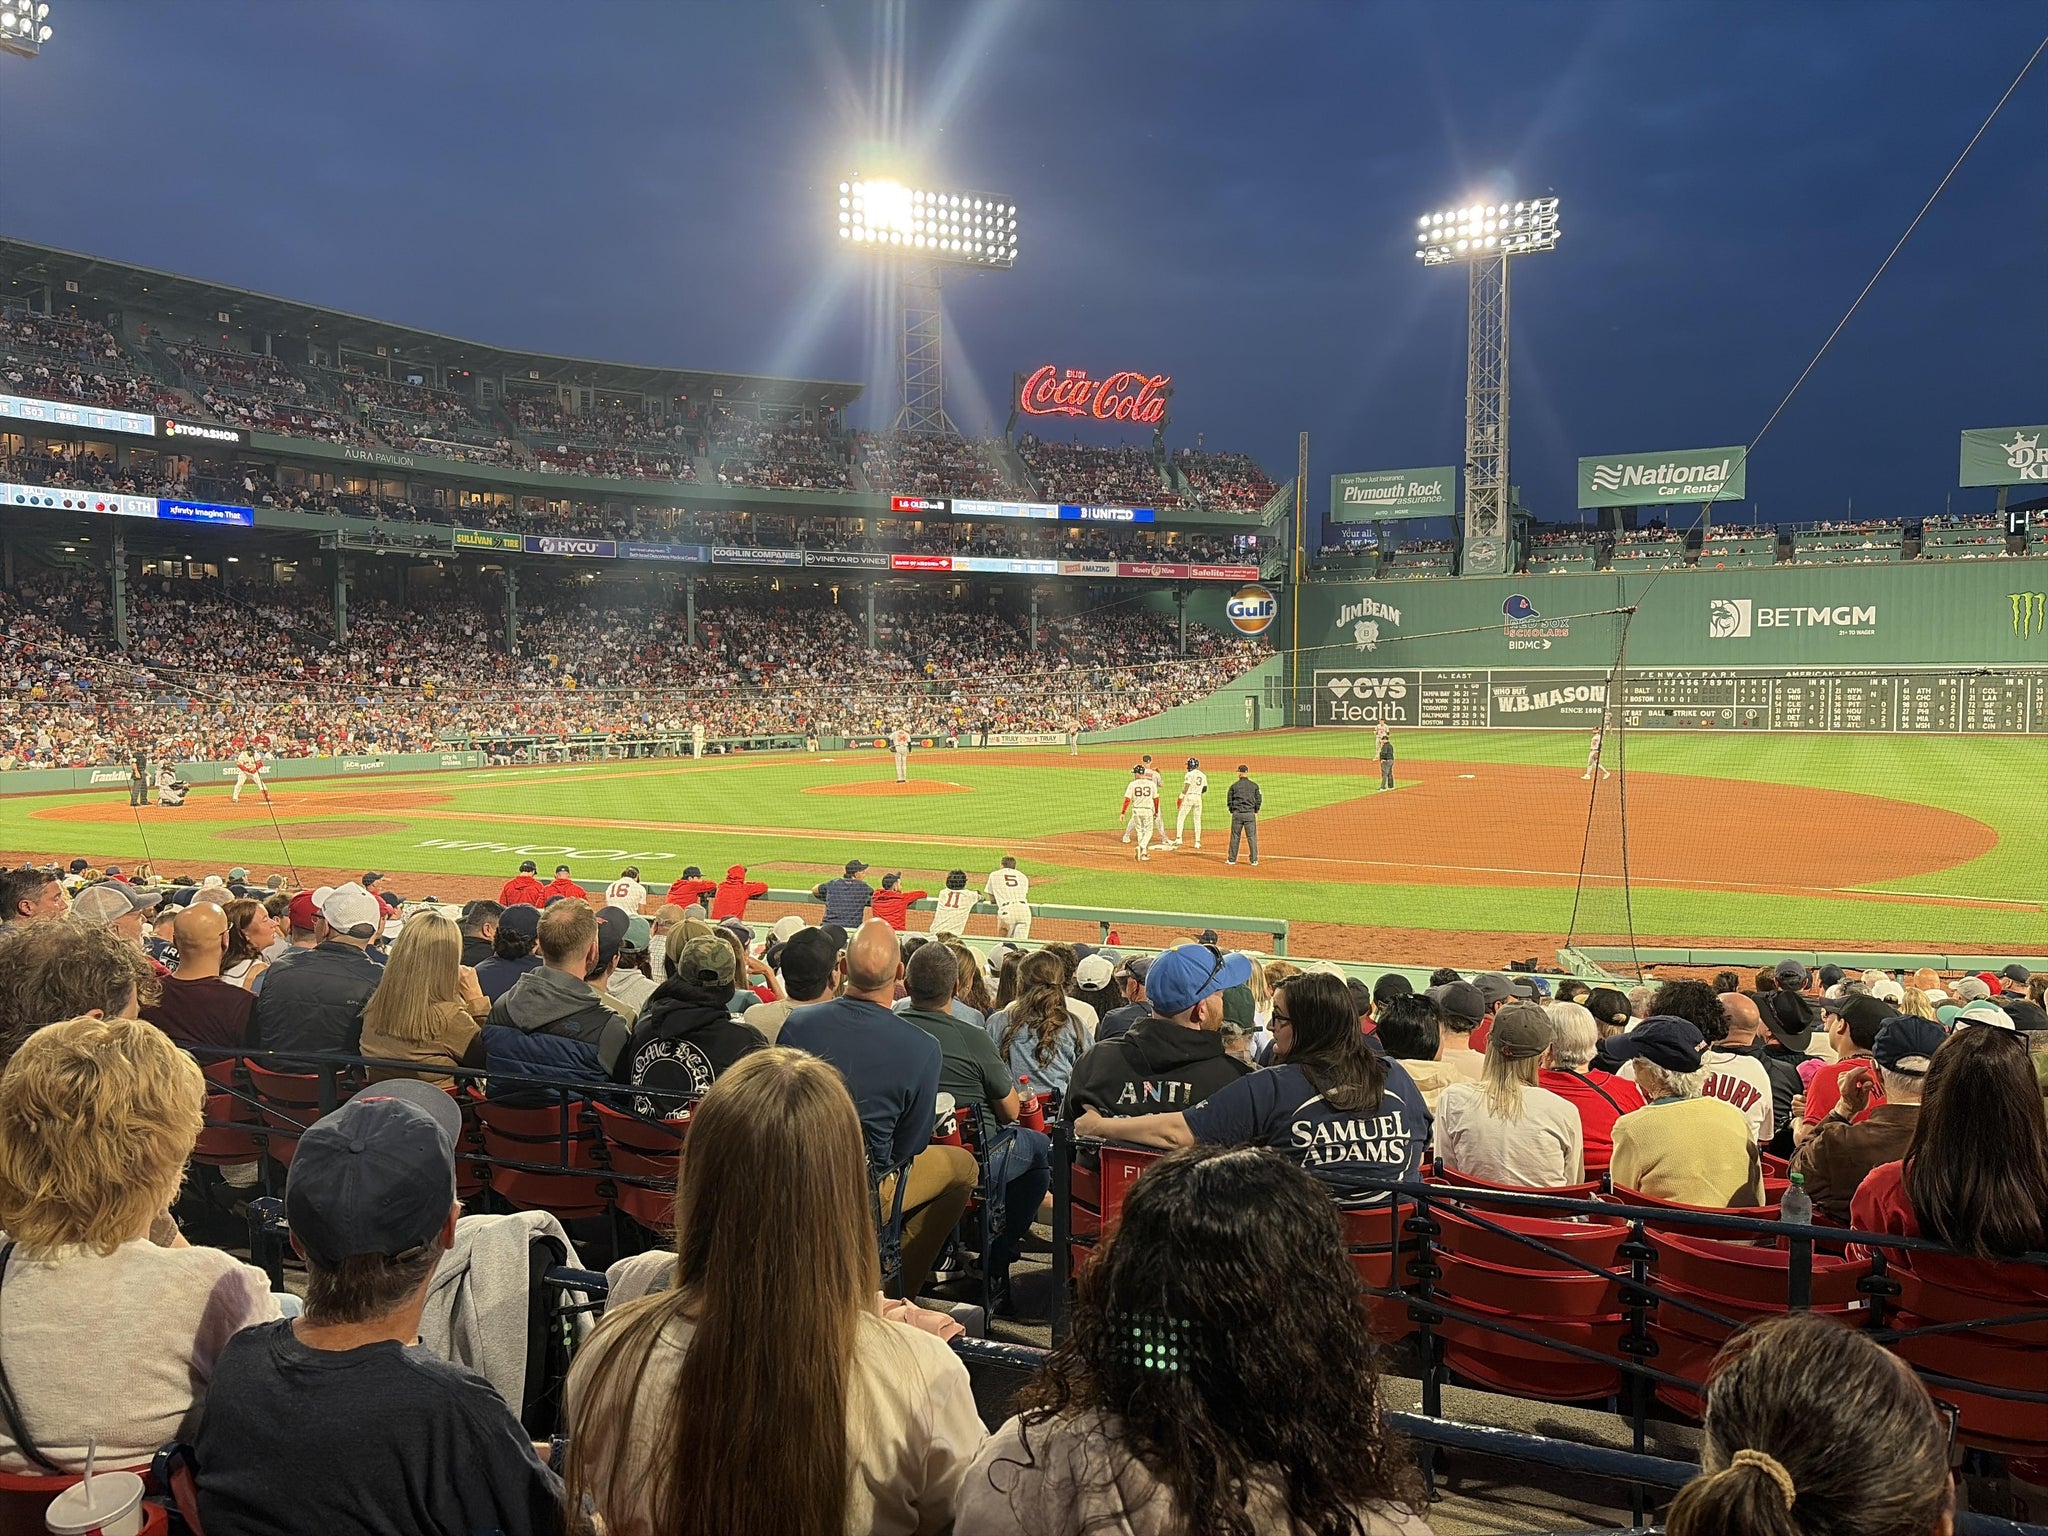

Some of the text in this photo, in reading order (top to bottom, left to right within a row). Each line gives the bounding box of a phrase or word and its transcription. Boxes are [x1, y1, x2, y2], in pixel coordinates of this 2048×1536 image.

[1067, 370, 1087, 379] ENJOY
[1022, 365, 1171, 422] Coca-Cola
[376, 453, 414, 467] PAVILION
[1622, 459, 1730, 486] National
[1344, 480, 1442, 504] Plymouth Rock
[1658, 483, 1724, 496] Car Rental
[60, 491, 89, 500] STRIKE
[98, 494, 115, 502] OUT
[1397, 496, 1442, 505] assurance
[128, 502, 151, 513] 6TH
[170, 506, 241, 520] xfinity Imagine That
[1092, 508, 1134, 520] UNITED
[1341, 528, 1360, 538] Your
[456, 534, 520, 548] SULLIVAN TIRE
[557, 541, 596, 554] HYCU
[714, 550, 800, 560] COGHLIN COMPANIES
[815, 556, 887, 565] VINEYARD VINES
[1132, 566, 1151, 575] Ninety
[1192, 568, 1224, 577] Safelite
[1228, 600, 1274, 617] Gulf
[1336, 598, 1401, 628] JIM BEAM
[1510, 619, 1570, 628] RED SOX
[1757, 606, 1876, 628] BETMGM
[1510, 628, 1569, 638] SCHOLARS
[1508, 640, 1540, 650] BIDMC
[1353, 678, 1407, 698] CVS
[1492, 688, 1511, 696] WHO
[1330, 701, 1407, 720] Health
[360, 762, 384, 770] TICKET
[1195, 776, 1203, 786] 3
[1134, 786, 1151, 797] 83
[412, 838, 677, 861] WHOOP
[1004, 875, 1018, 887] 5
[609, 884, 630, 898] 16
[944, 891, 960, 908] 11
[1116, 1081, 1193, 1105] ANTI
[1290, 1111, 1411, 1147] SAMUEL
[1301, 1139, 1406, 1168] ADAMS
